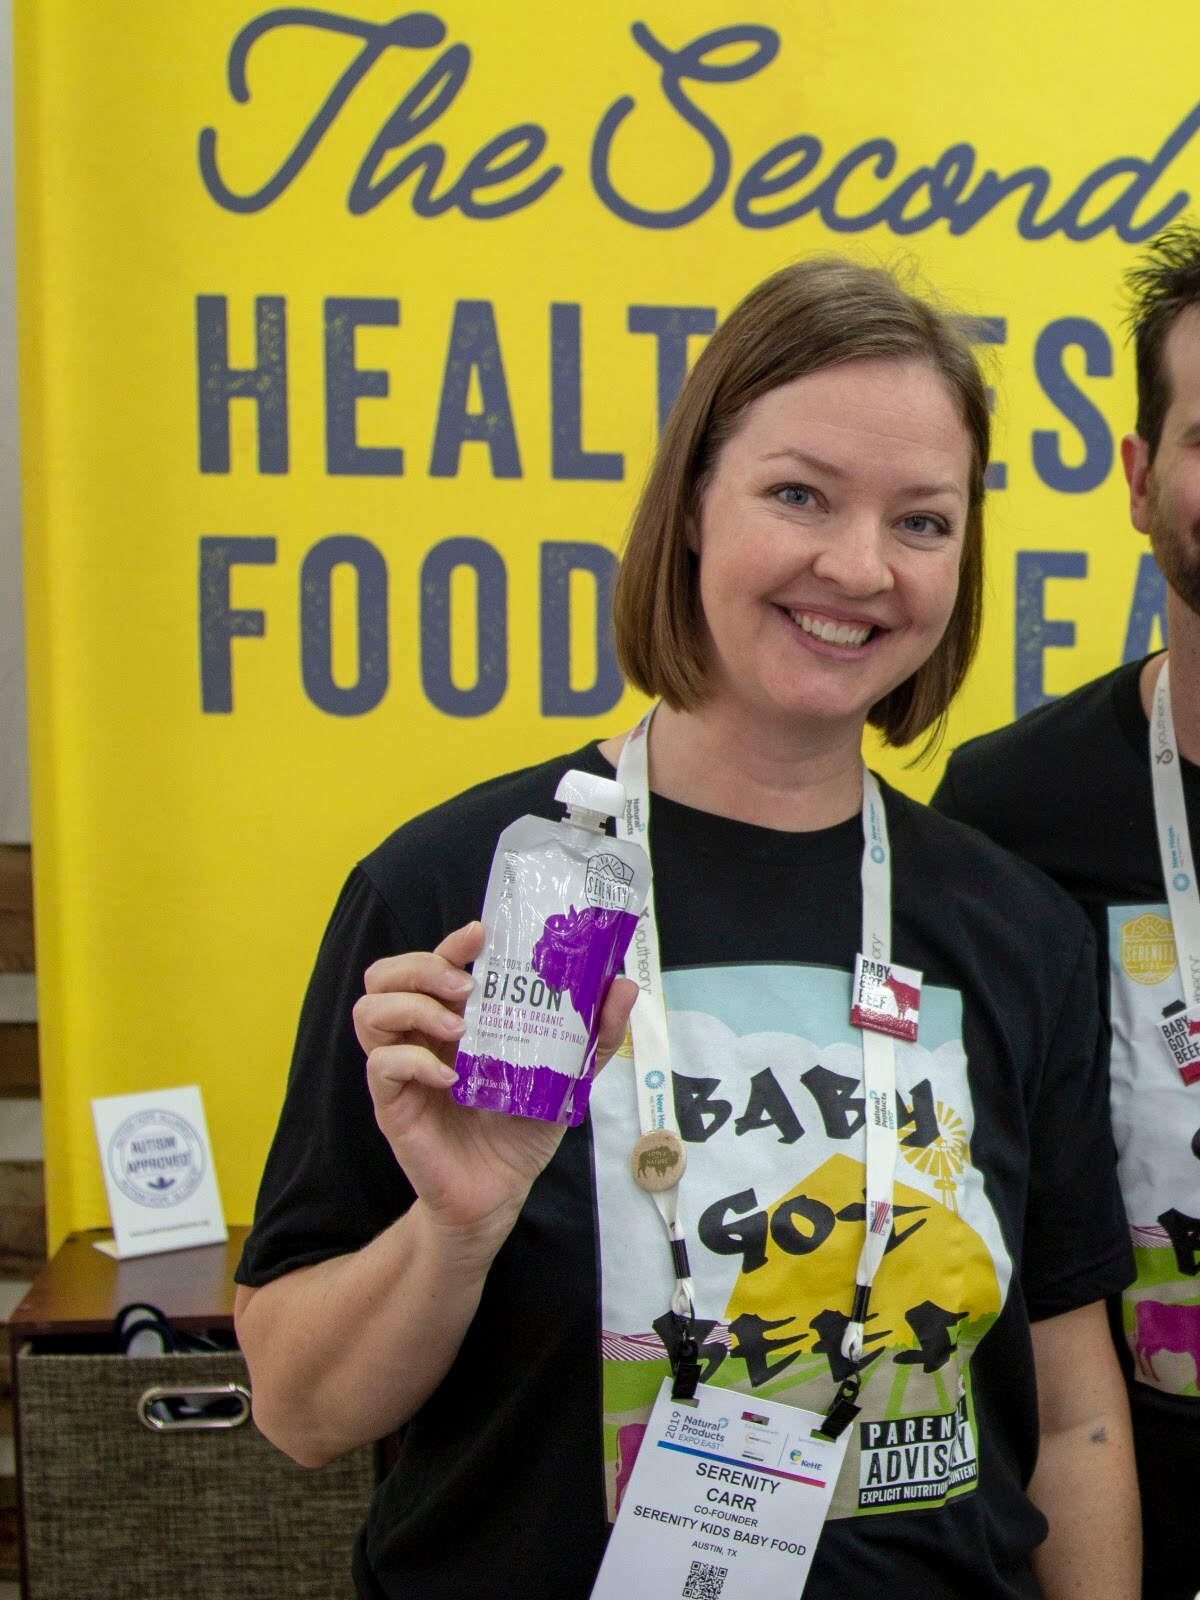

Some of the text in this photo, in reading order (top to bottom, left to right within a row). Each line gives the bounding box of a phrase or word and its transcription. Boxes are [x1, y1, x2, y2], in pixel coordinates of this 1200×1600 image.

[199, 7, 563, 218] The
[198, 535, 624, 718] FOOD
[626, 799, 634, 835] Products
[632, 798, 641, 828] Natural
[636, 922, 651, 994] youtheory
[862, 959, 891, 980] BABY
[483, 971, 563, 1011] BISON
[478, 1015, 514, 1030] KABOCHA
[517, 1022, 549, 1037] SQUASH
[480, 1003, 501, 1014] MADE
[530, 1011, 564, 1027] ORGANIC
[1161, 1015, 1191, 1038] BABY
[507, 1036, 530, 1044] protein
[1168, 1032, 1189, 1052] GOT
[1174, 1042, 1200, 1064] BEEF
[656, 1094, 664, 1112] New
[665, 1411, 681, 1439] 2019
[681, 1424, 725, 1442] Products
[683, 1415, 721, 1431] Natural
[678, 1433, 722, 1450] EXPO EAST
[801, 1459, 822, 1471] KeHE
[696, 1463, 781, 1494] SERENITY
[706, 1488, 756, 1512] CARR
[861, 1487, 901, 1504] EXPLICIT
[903, 1480, 948, 1499] NUTRITIO
[693, 1504, 758, 1527] CO-FOUNDER
[633, 1505, 806, 1556] SERENITY KIDS BABY FOOD
[692, 1540, 738, 1557] AUSTIN, TX
